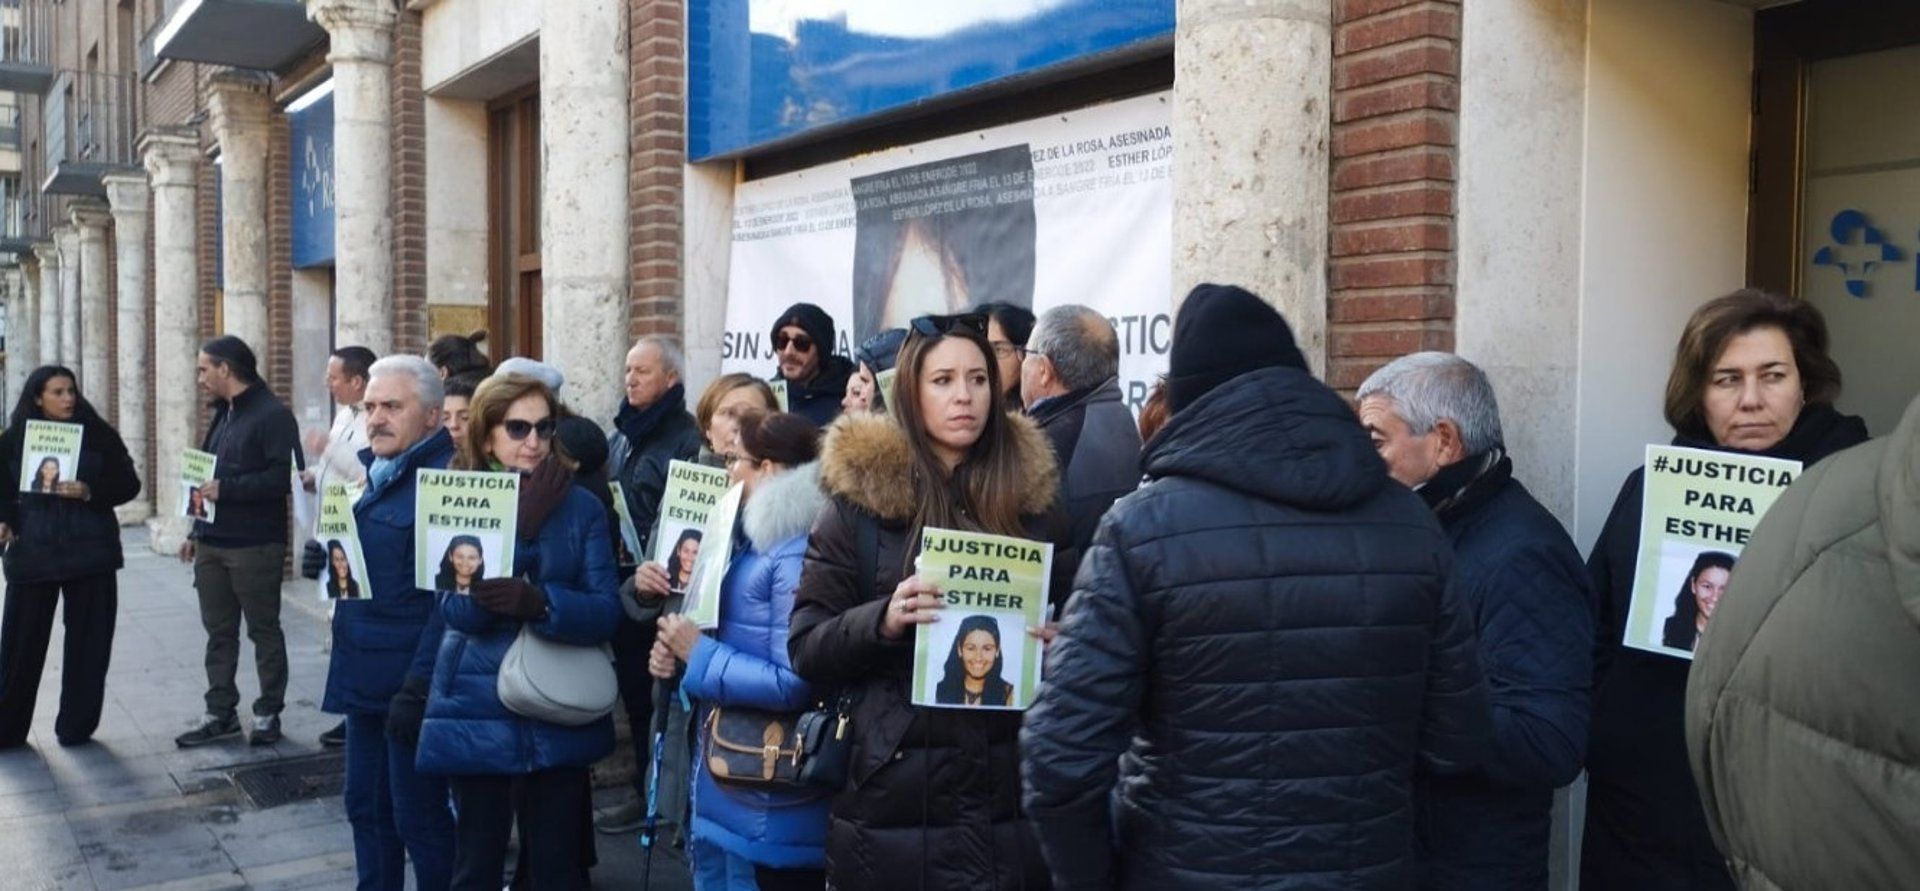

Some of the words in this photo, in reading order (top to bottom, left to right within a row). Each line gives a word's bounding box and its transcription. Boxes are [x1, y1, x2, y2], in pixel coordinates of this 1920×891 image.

[1046, 145, 1060, 161] DE
[1061, 143, 1075, 158] LA
[1109, 124, 1172, 149] ASESINADA
[1108, 149, 1150, 169] ESTHER
[722, 331, 760, 360] SIN
[420, 473, 517, 490] #JUSTICIA
[671, 467, 731, 489] #JUSTICI
[1653, 455, 1793, 488] #JUSTICIA
[441, 495, 491, 510] PARA
[679, 488, 716, 506] PARA
[1684, 489, 1756, 516] PARA
[428, 513, 502, 530] ESTHER
[668, 505, 708, 525] ESTH
[1665, 516, 1752, 546] ESTHE
[923, 535, 1043, 564] #JUSTICIA
[949, 564, 1011, 584] PARA
[934, 589, 1025, 610] STHER
